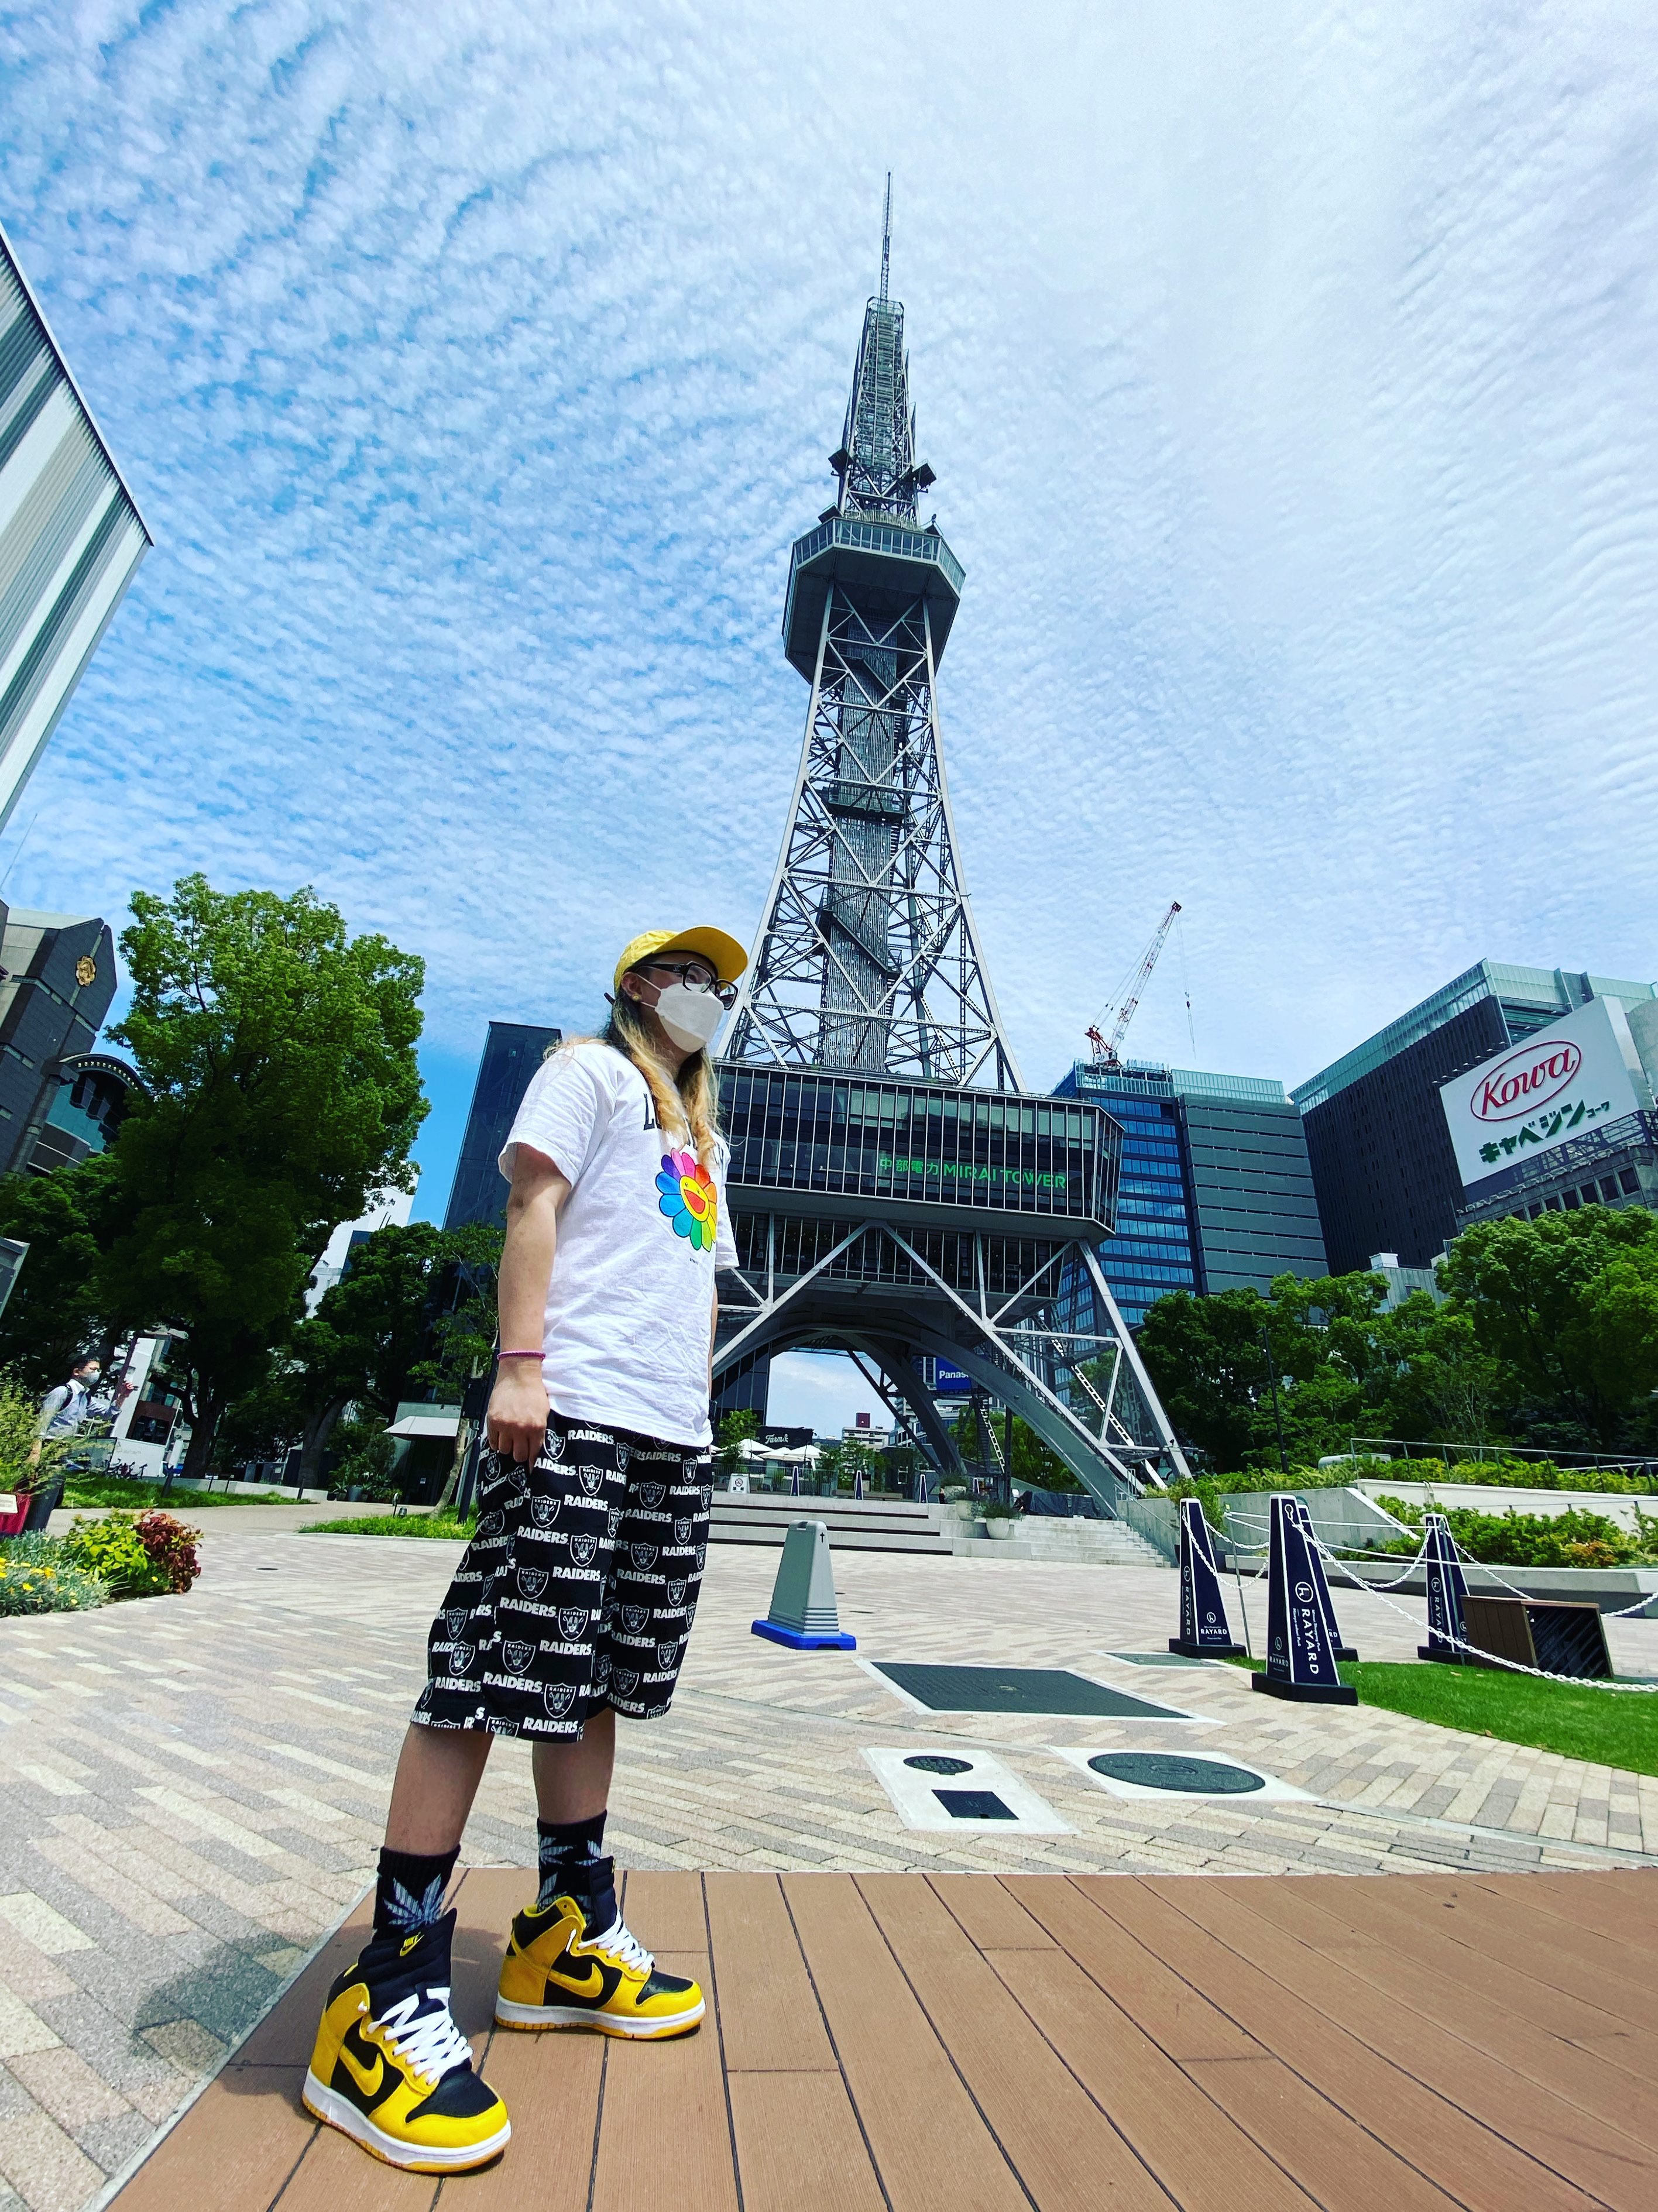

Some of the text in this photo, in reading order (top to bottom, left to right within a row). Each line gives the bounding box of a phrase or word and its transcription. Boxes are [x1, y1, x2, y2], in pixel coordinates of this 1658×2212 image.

[1481, 1048, 1575, 1115] Kowa
[1478, 1099, 1585, 1163] キャベジン
[879, 1157, 1066, 1189] 中部電力 MIRAI TOWER
[939, 1370, 969, 1379] Panas
[568, 1430, 615, 1445] RAIDERS
[534, 1457, 577, 1476] AIDERS
[670, 1486, 701, 1495] RAIDERS
[564, 1494, 609, 1512] RAIDERS
[517, 1526, 569, 1545] RAIDERS
[662, 1545, 696, 1556] RAIDERS
[552, 1566, 600, 1582] RAIDERS
[617, 1568, 667, 1585] RAIDERS
[499, 1596, 558, 1618] RAIDERS
[540, 1640, 592, 1655] RAIDERS
[1301, 1609, 1319, 1674] RAYARD
[435, 1677, 482, 1692] RAIDERS
[483, 1671, 543, 1693] RAIDERS
[523, 1716, 578, 1733] RAIDERS
